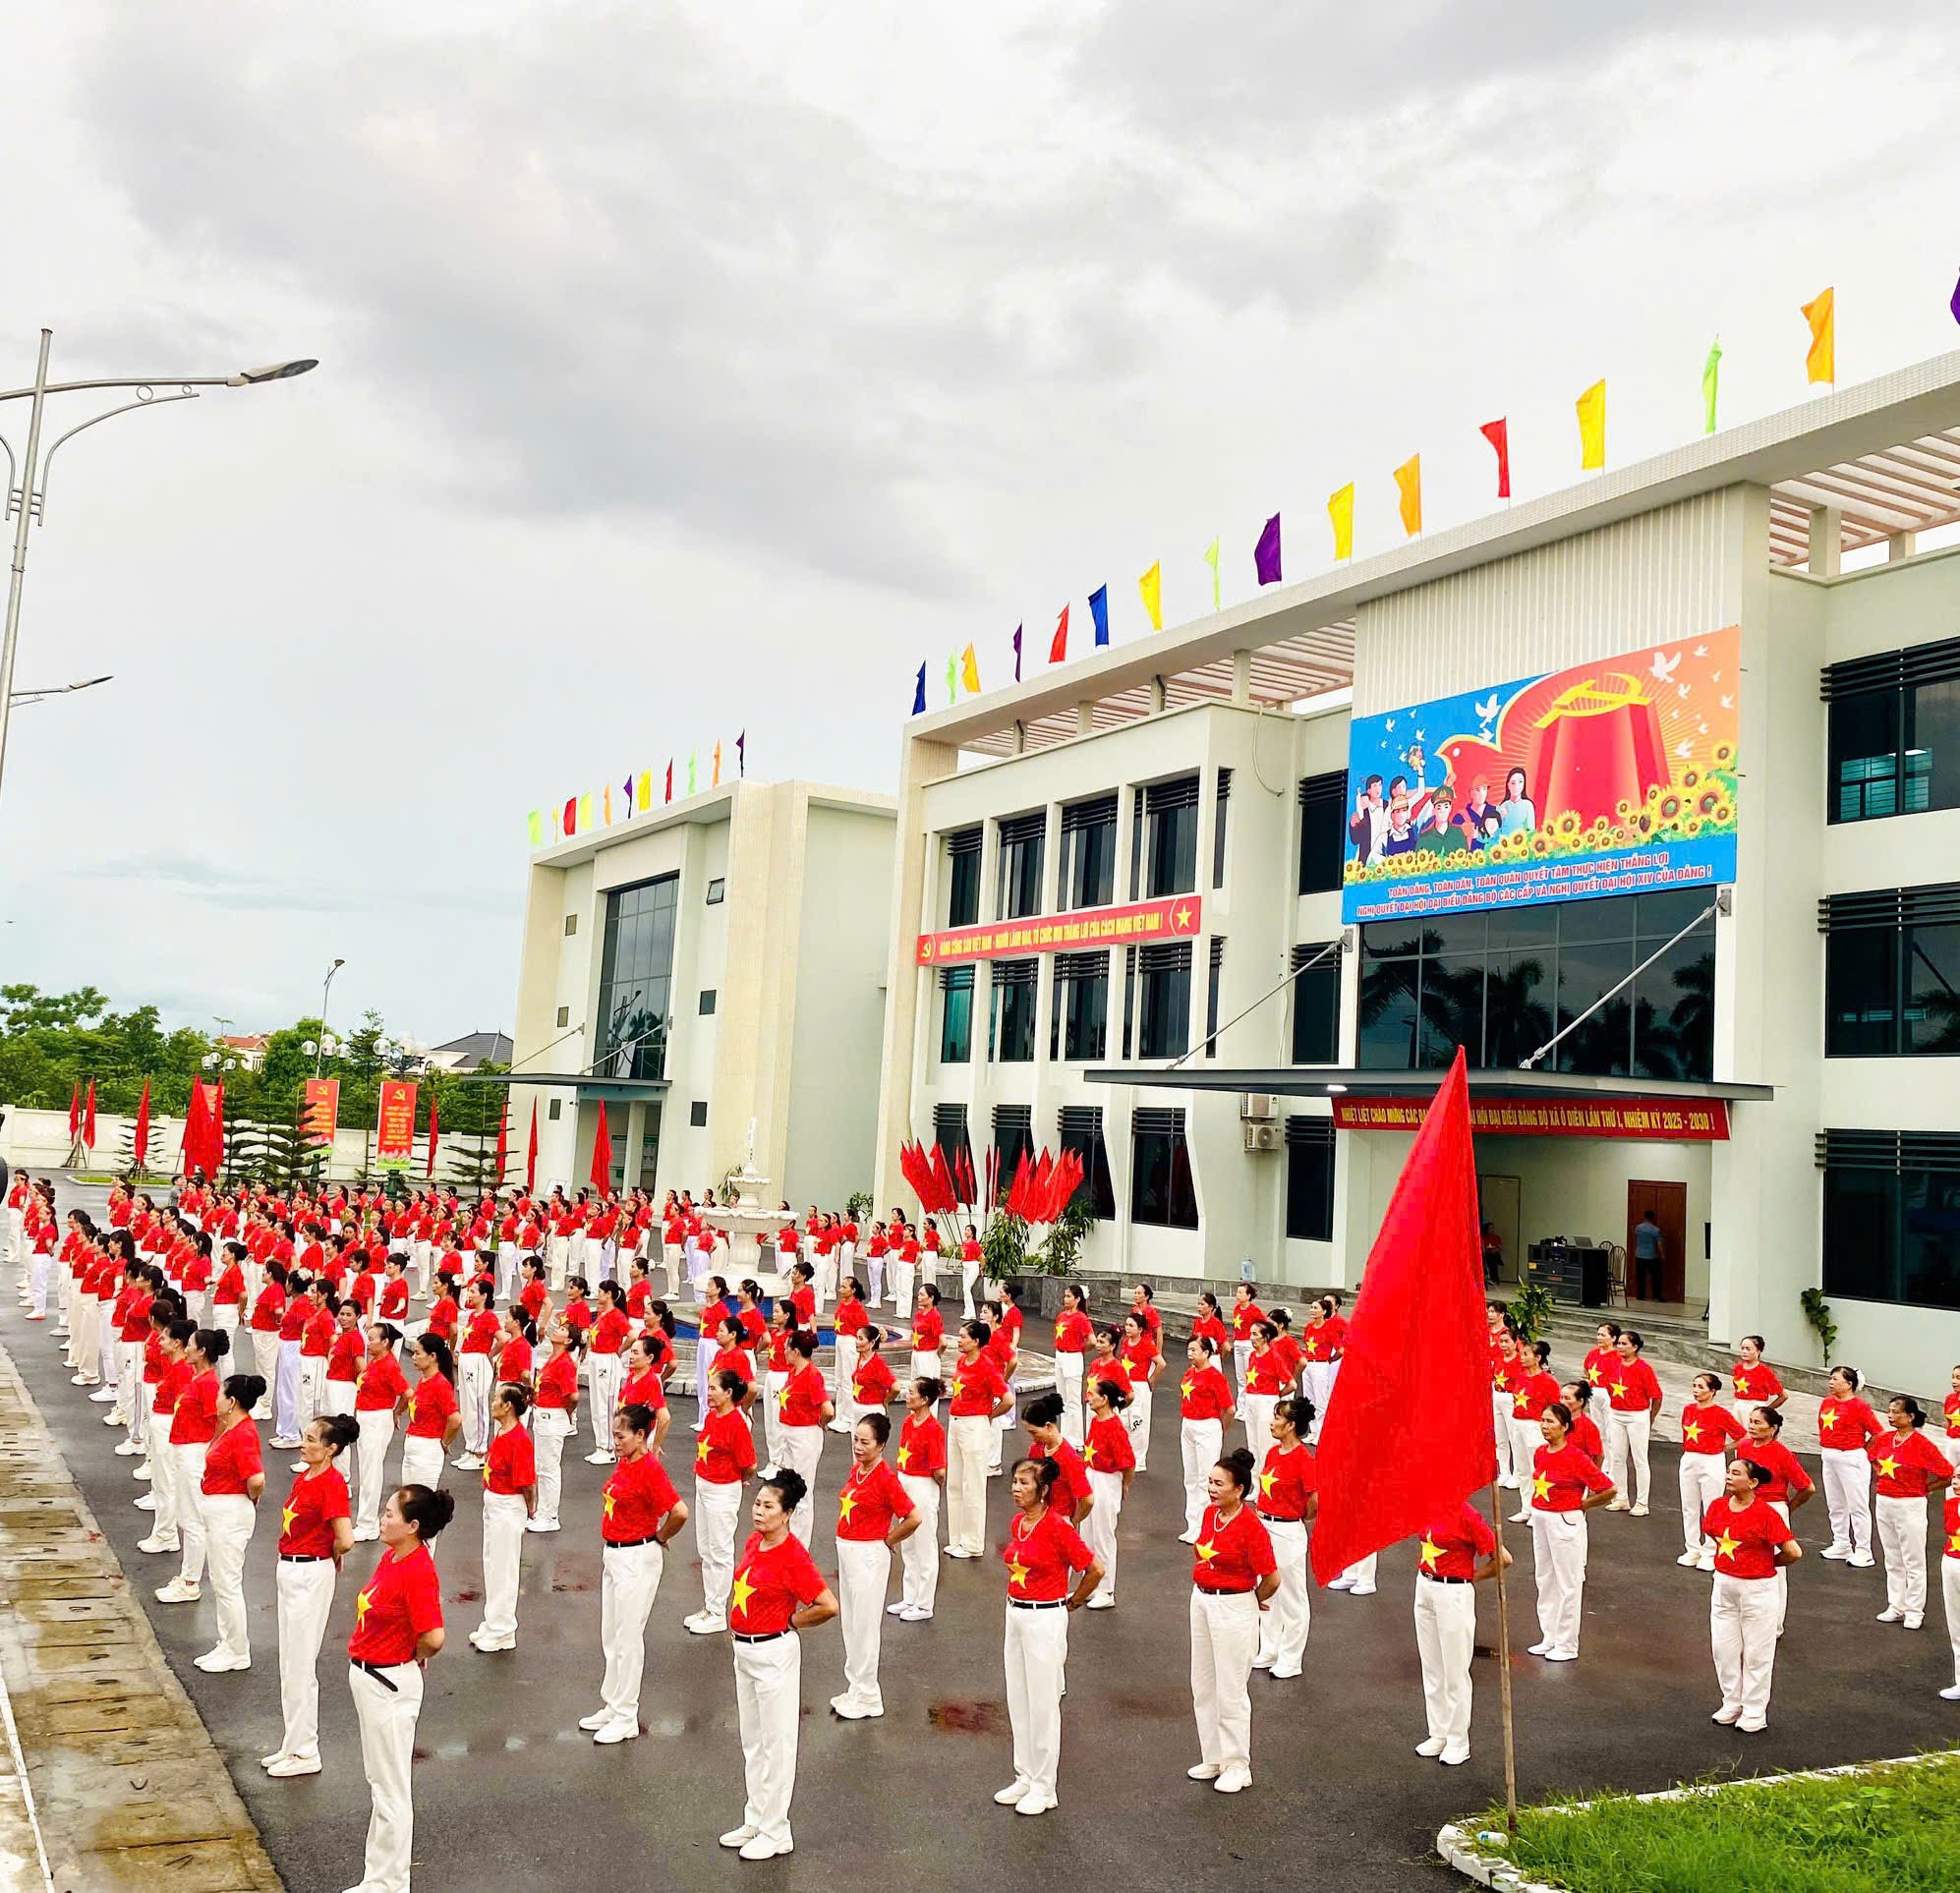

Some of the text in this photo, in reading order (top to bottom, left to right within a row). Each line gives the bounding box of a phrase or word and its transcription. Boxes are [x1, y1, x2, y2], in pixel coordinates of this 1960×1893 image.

[1357, 904, 1376, 917] NGHỊ
[1376, 899, 1400, 915] QUYẾT
[1400, 900, 1413, 914] ĐẠI
[1413, 896, 1428, 912] HỘI
[1428, 897, 1441, 911] ĐẠI
[1462, 890, 1484, 905] ĐẢNG
[1485, 889, 1497, 904] BỘ
[1498, 888, 1516, 902] CÁC
[1517, 883, 1534, 899] CẤP
[1535, 884, 1547, 897] VÀ
[1549, 882, 1571, 896] NGHỊ
[1572, 876, 1600, 893] QUYẾT
[1601, 876, 1618, 891] ĐẠI
[1619, 873, 1636, 889] HỘI
[1638, 871, 1653, 886] XIV
[1655, 867, 1675, 884] CỦA
[1677, 863, 1705, 881] ĐẢNG
[1706, 864, 1712, 878] !
[1388, 886, 1409, 899] TOÀN
[1433, 880, 1454, 892] TOÀN
[1476, 874, 1498, 888] TOÀN
[1498, 871, 1522, 886] QUÂN
[1523, 866, 1549, 883] QUYẾT
[1550, 865, 1571, 880] TÂM
[1572, 861, 1595, 877] THỰC
[1596, 858, 1619, 874] HIỆN
[1620, 852, 1651, 870] THẮNG
[1652, 851, 1669, 867] LỢI
[1662, 1112, 1683, 1129] 2025
[1689, 1113, 1709, 1130] 2030
